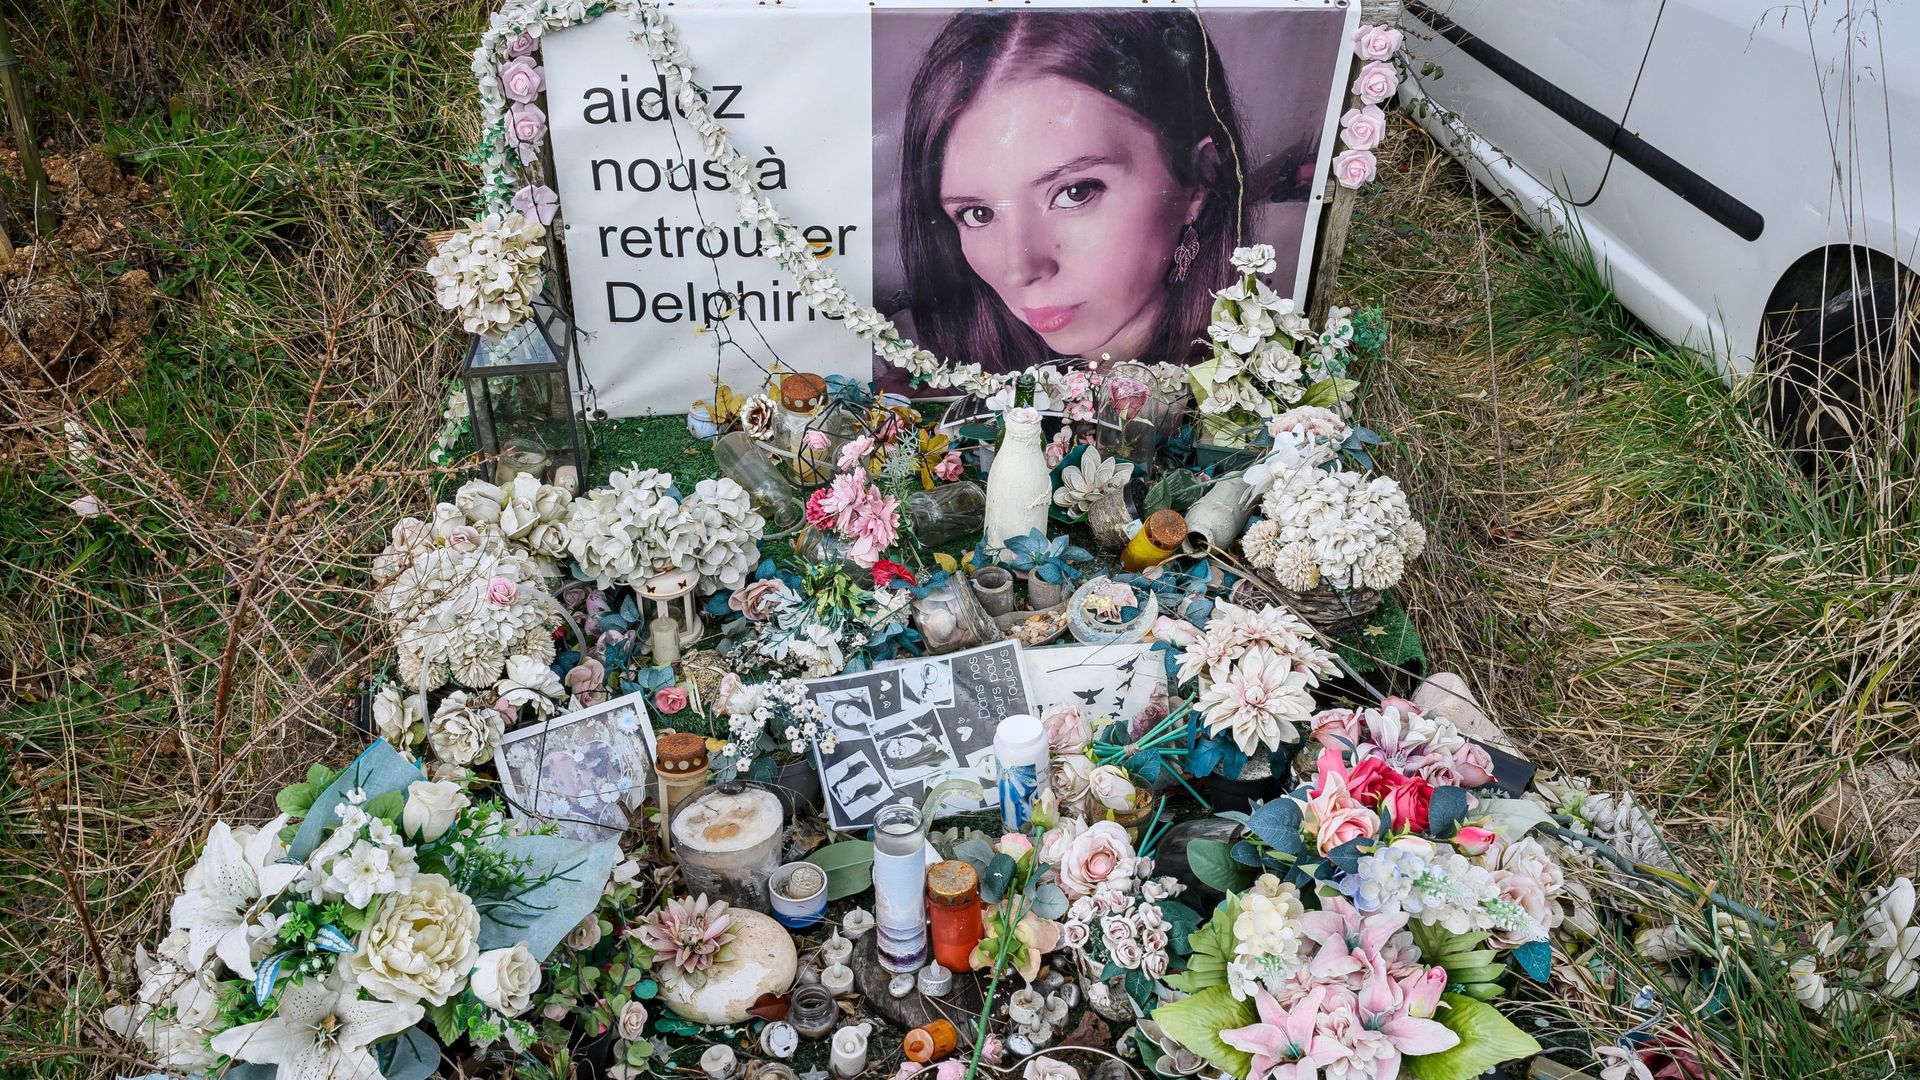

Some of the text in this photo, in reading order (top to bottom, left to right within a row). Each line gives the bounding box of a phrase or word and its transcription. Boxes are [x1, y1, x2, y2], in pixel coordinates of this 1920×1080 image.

[591, 145, 788, 192] nous à
[598, 216, 858, 258] retrouer
[605, 279, 846, 328] Delphin
[969, 656, 991, 719] Dans nos
[984, 653, 1002, 683] pour
[1000, 649, 1019, 705] Toujours
